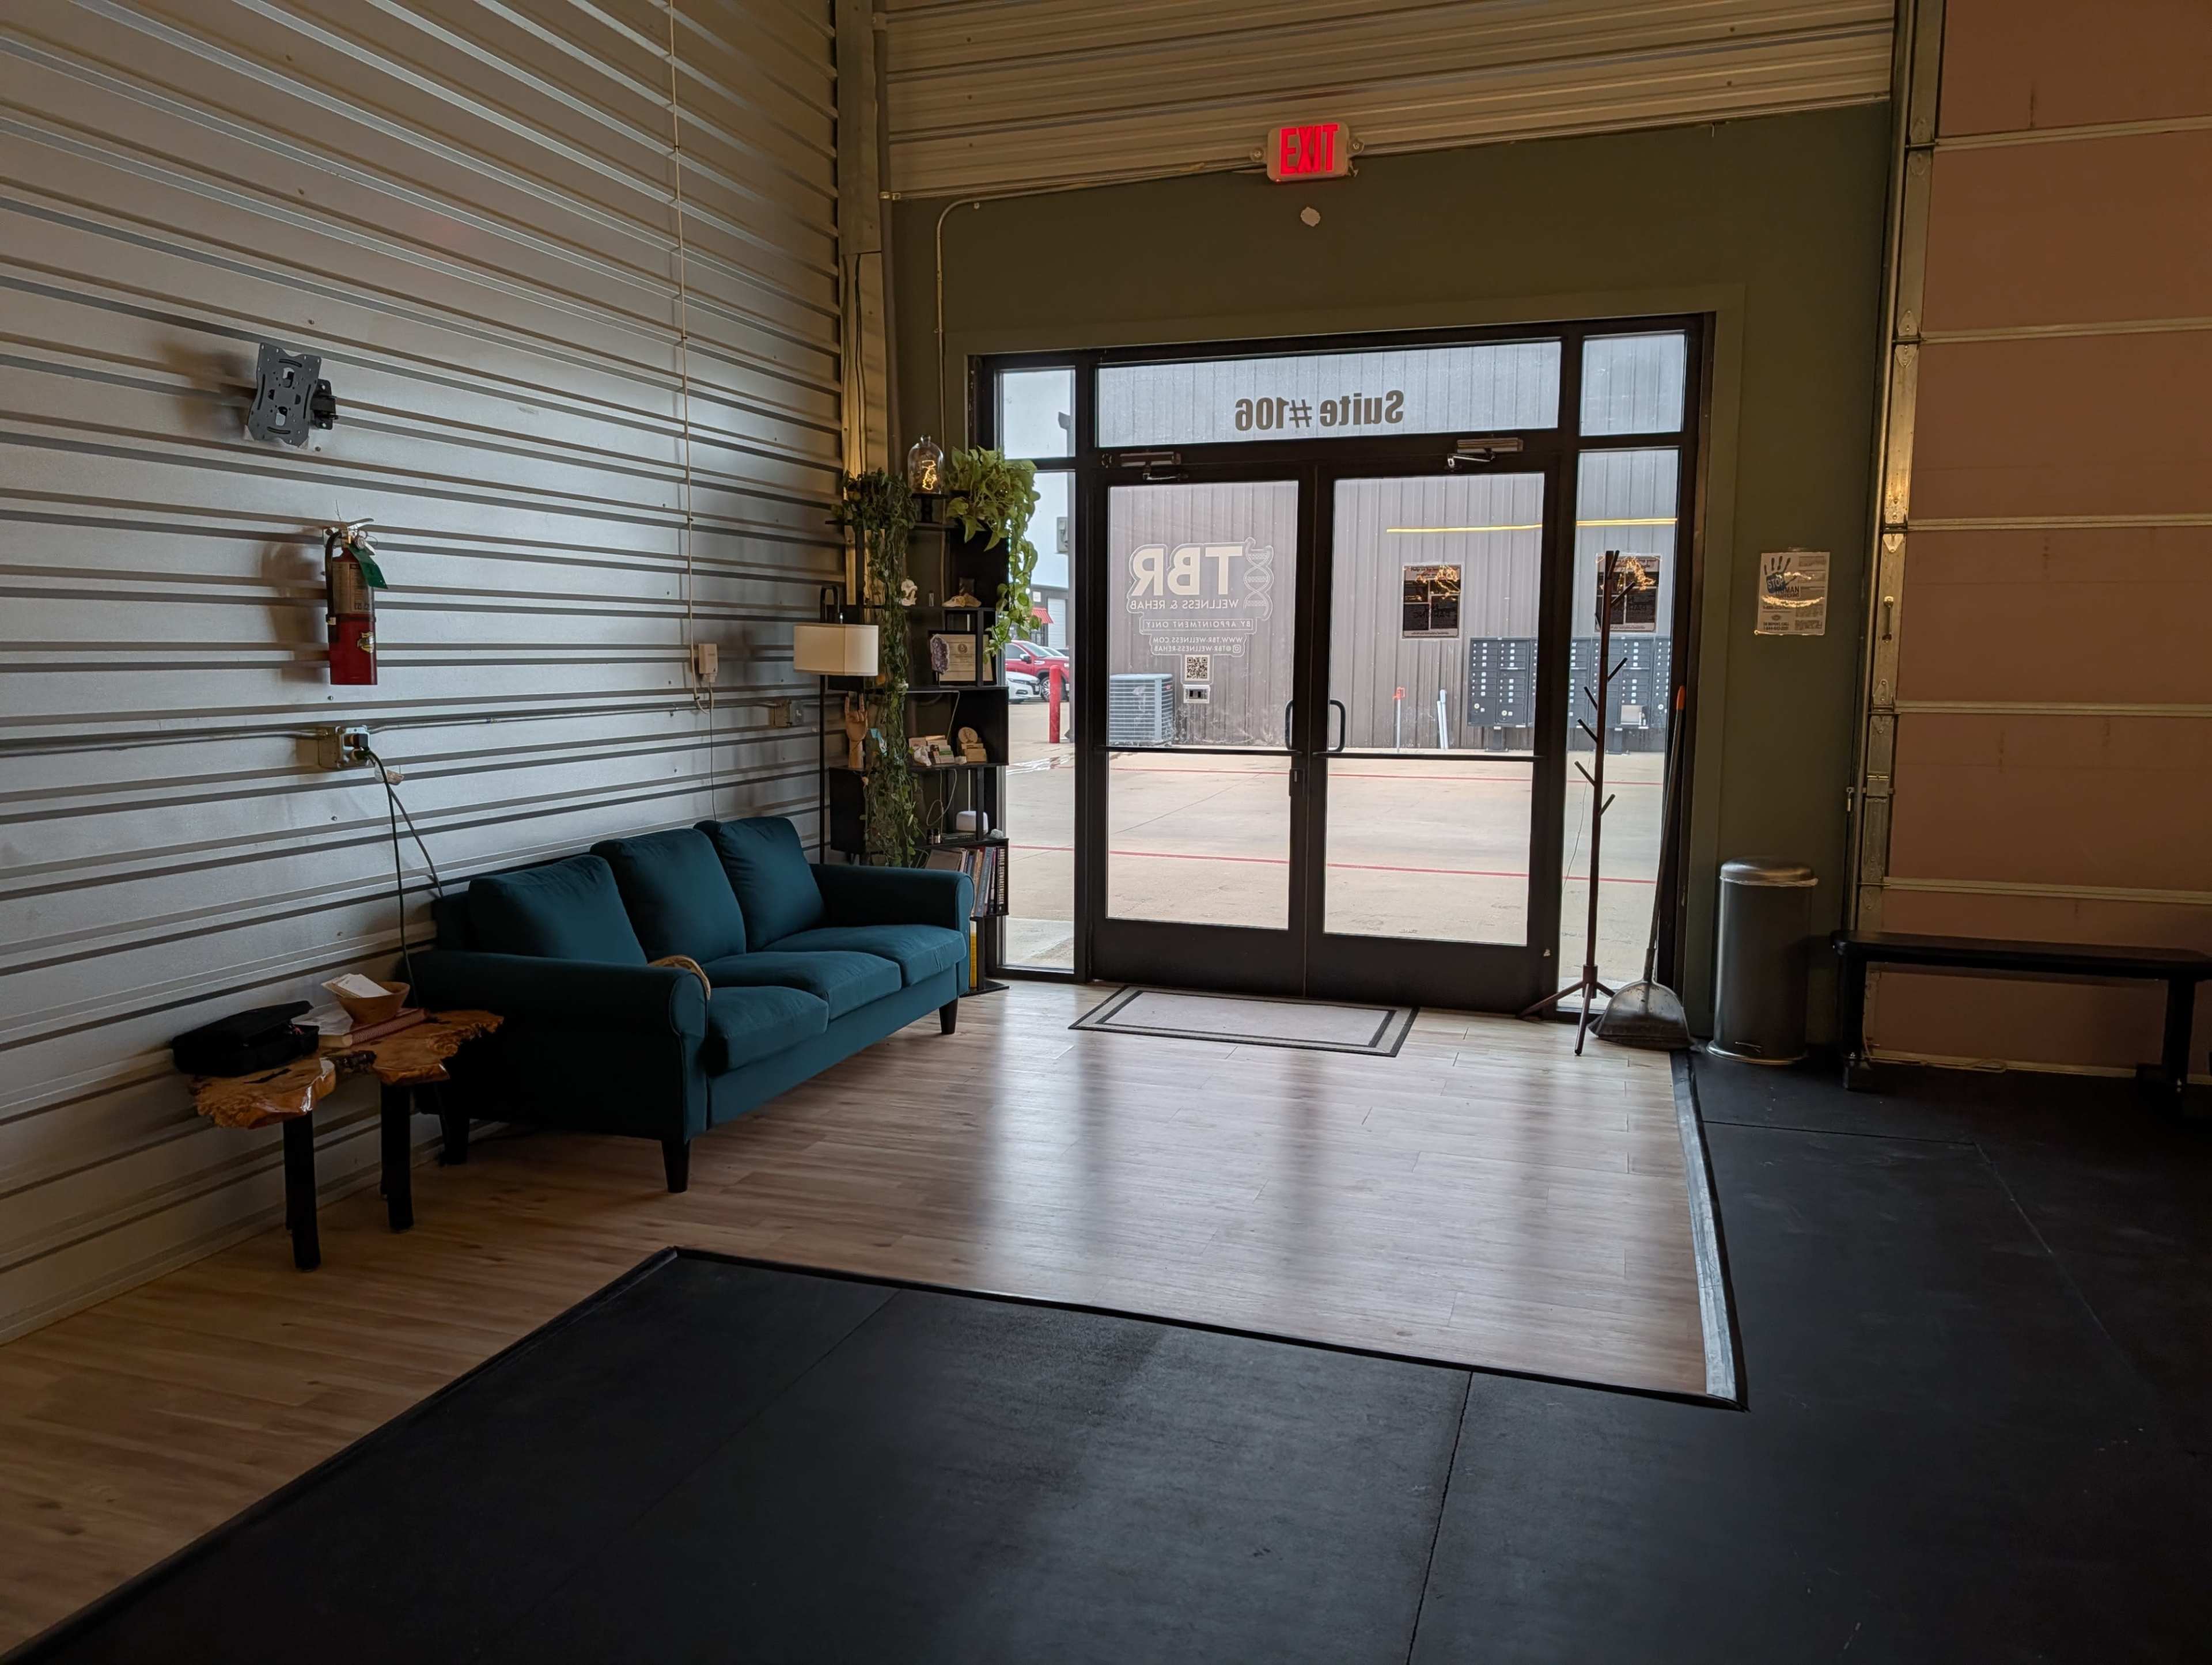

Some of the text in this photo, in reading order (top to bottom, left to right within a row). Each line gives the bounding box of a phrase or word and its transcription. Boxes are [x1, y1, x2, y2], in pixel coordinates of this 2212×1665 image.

[1279, 123, 1339, 175] EXIT
[1767, 578, 1784, 589] STOP
[1775, 586, 1800, 594] HUMAN
